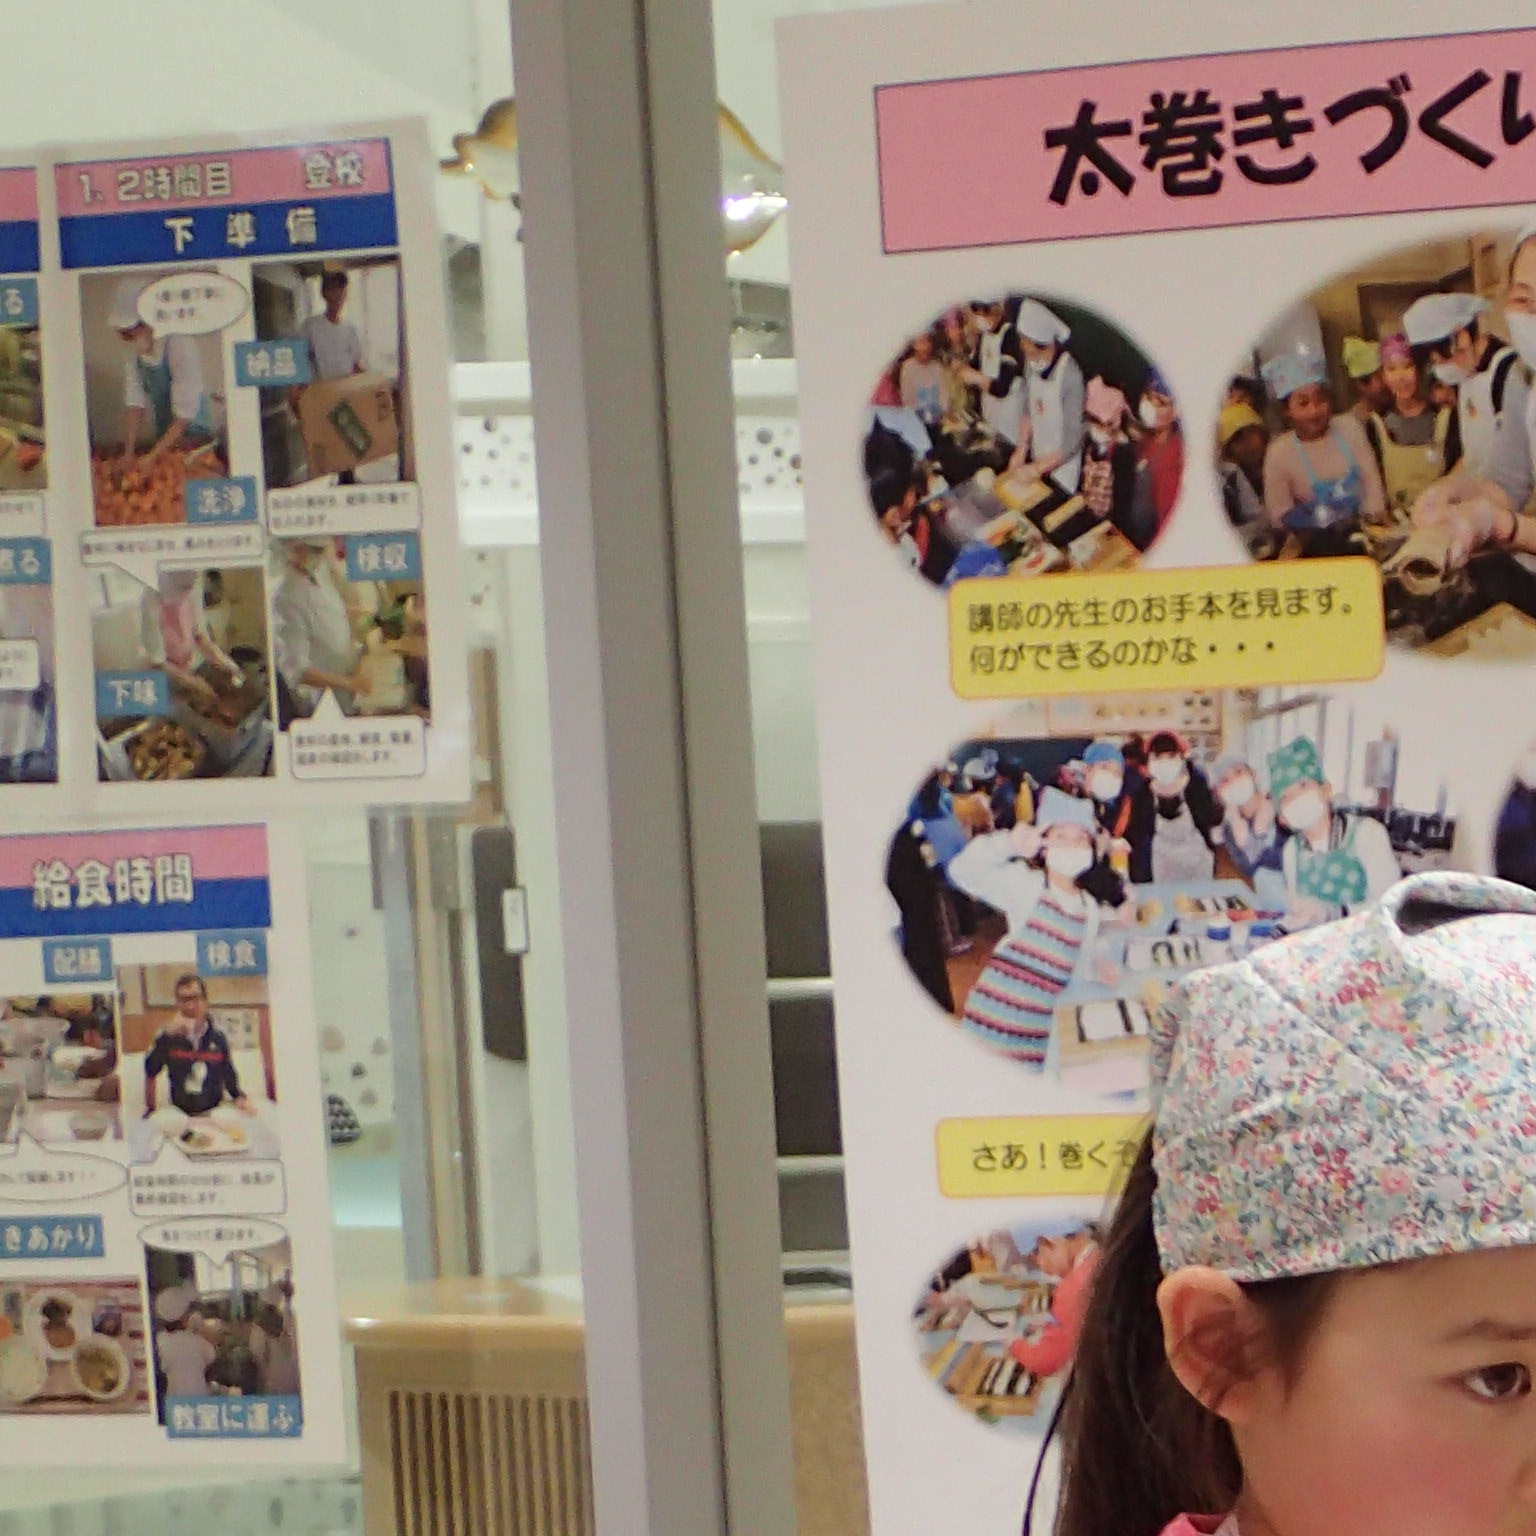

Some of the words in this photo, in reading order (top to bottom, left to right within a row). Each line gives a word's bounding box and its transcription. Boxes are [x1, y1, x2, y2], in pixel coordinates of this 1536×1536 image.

[968, 584, 1354, 634] 講師の先生のお手本を見ます。
[32, 852, 196, 912] 給食時間
